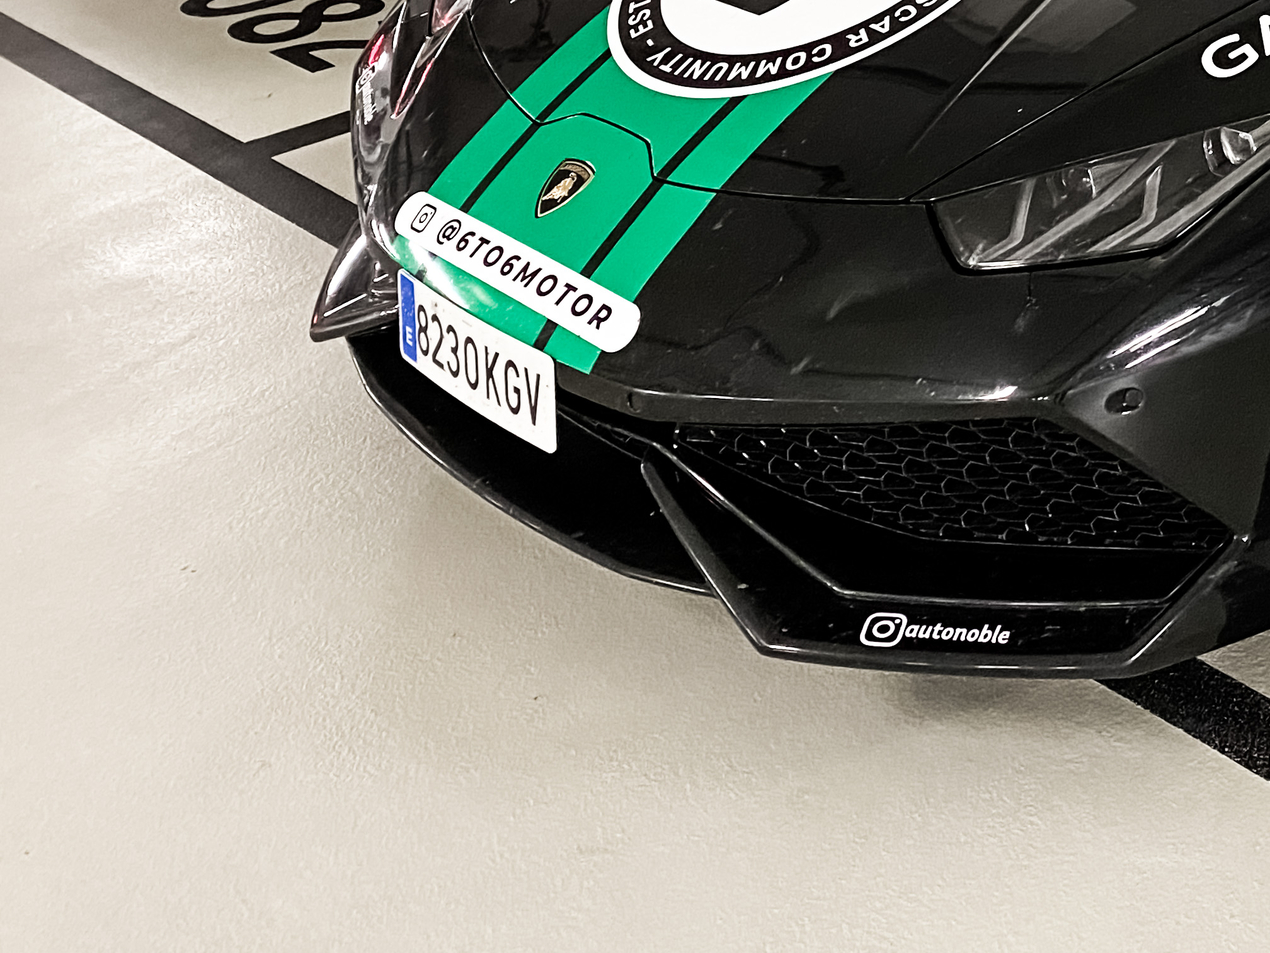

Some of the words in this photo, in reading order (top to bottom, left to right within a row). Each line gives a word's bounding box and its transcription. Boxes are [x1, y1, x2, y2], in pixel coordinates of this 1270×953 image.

[645, 42, 834, 82] COMMUNITY
[436, 218, 613, 331] @6TO6MOTOR
[416, 304, 541, 427] 8230KGV
[904, 622, 1011, 644] autonoble
